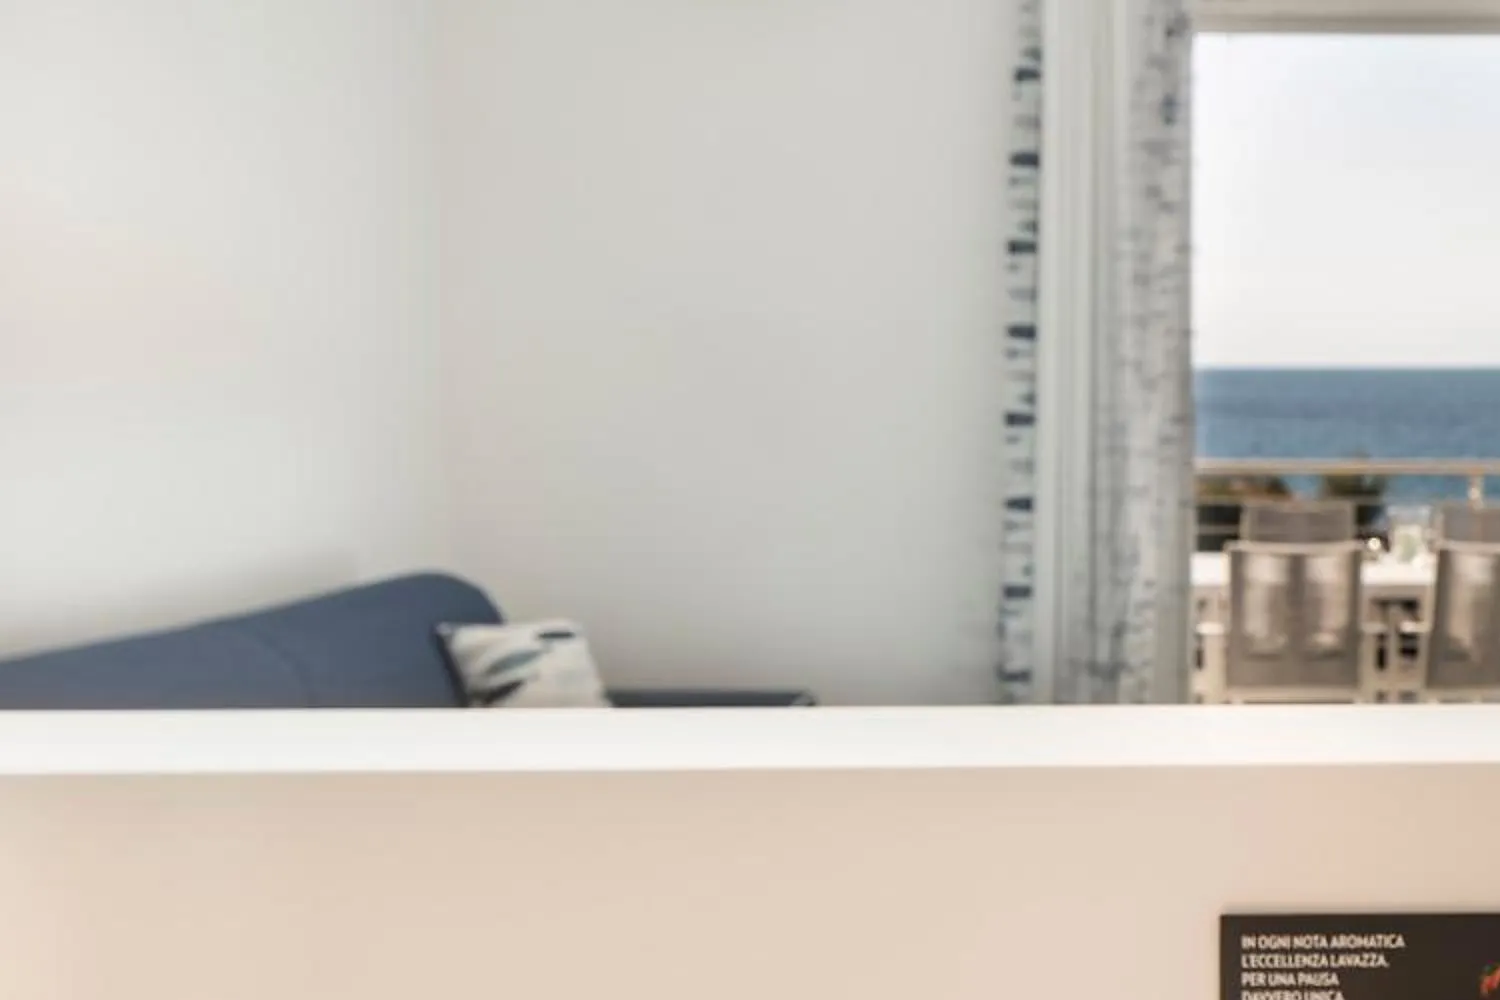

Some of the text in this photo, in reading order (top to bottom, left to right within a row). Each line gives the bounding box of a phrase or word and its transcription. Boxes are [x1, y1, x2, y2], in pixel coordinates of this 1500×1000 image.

[1241, 934, 1405, 949] IN OGNI NOTA AROMATICA
[1241, 953, 1328, 968] L'ECCELLENZA
[1241, 972, 1340, 987] PER UNA PAUSA
